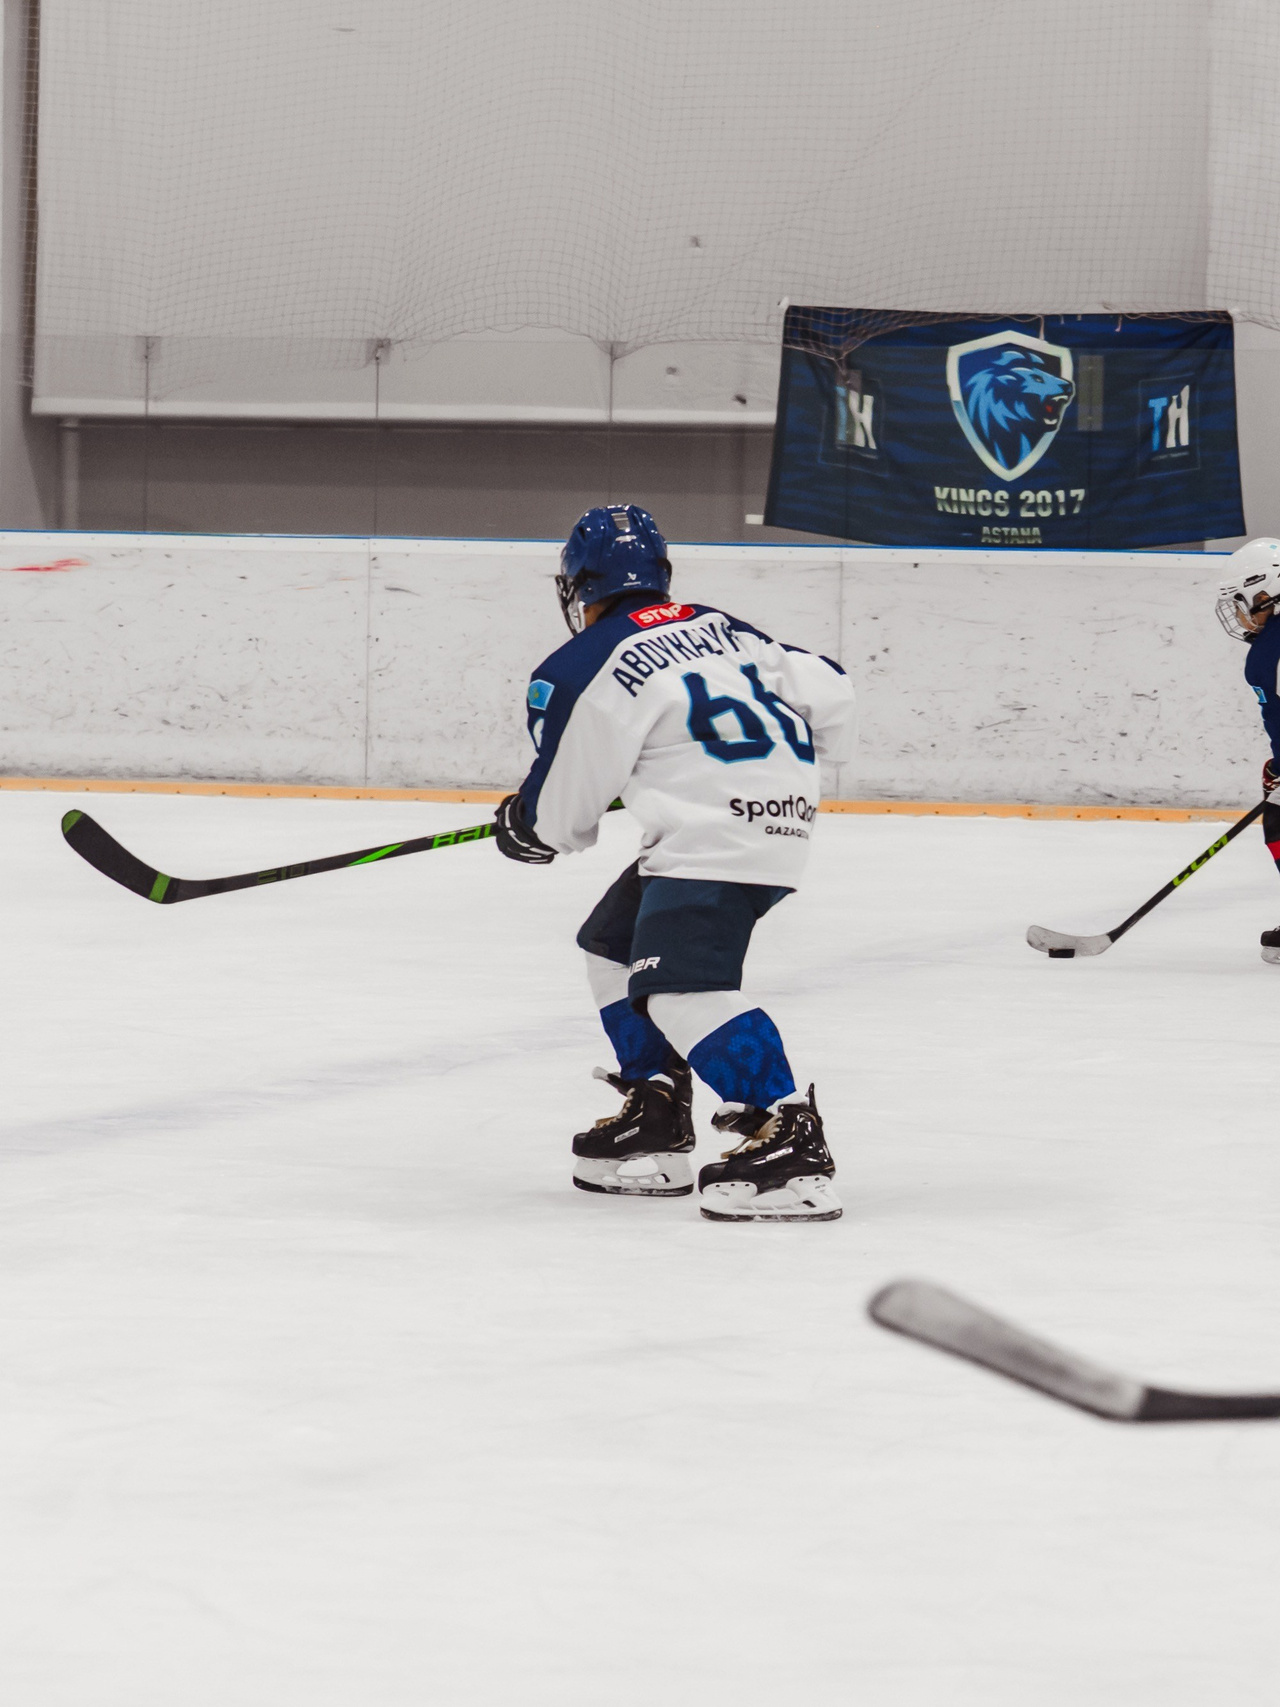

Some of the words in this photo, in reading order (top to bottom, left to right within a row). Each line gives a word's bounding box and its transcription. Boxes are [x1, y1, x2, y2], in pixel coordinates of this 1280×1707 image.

[934, 486, 1010, 518] KINGS
[1019, 489, 1086, 518] 2017
[981, 526, 1043, 545] ASTANA
[638, 604, 683, 624] STOP
[681, 662, 816, 765] 66
